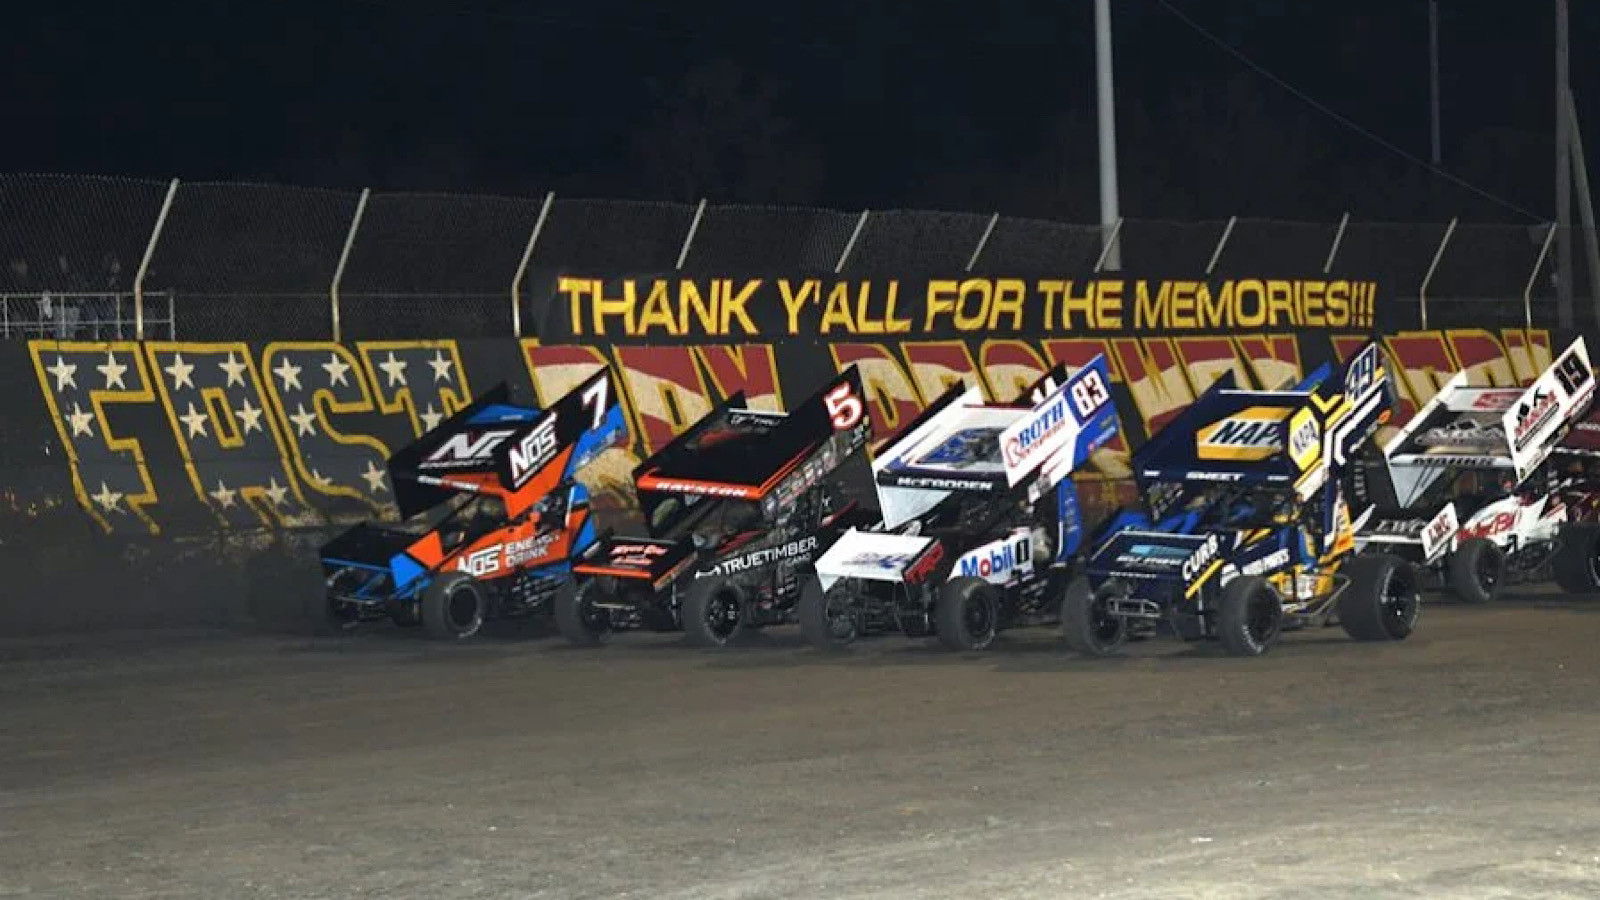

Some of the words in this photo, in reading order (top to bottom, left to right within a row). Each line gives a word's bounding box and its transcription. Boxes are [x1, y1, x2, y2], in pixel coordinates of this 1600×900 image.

[558, 275, 764, 336] THANK
[779, 278, 912, 334] Y'ALL
[923, 279, 1027, 332] FOR
[1037, 280, 1124, 331] THE
[1134, 279, 1377, 329] MEMORIES!!!
[1071, 369, 1109, 417] 83
[1553, 349, 1592, 396] 19
[581, 375, 609, 431] 7
[824, 383, 864, 428] 5
[508, 410, 558, 479] NOS
[457, 543, 504, 577] NOS
[961, 543, 1014, 577] Mobil
